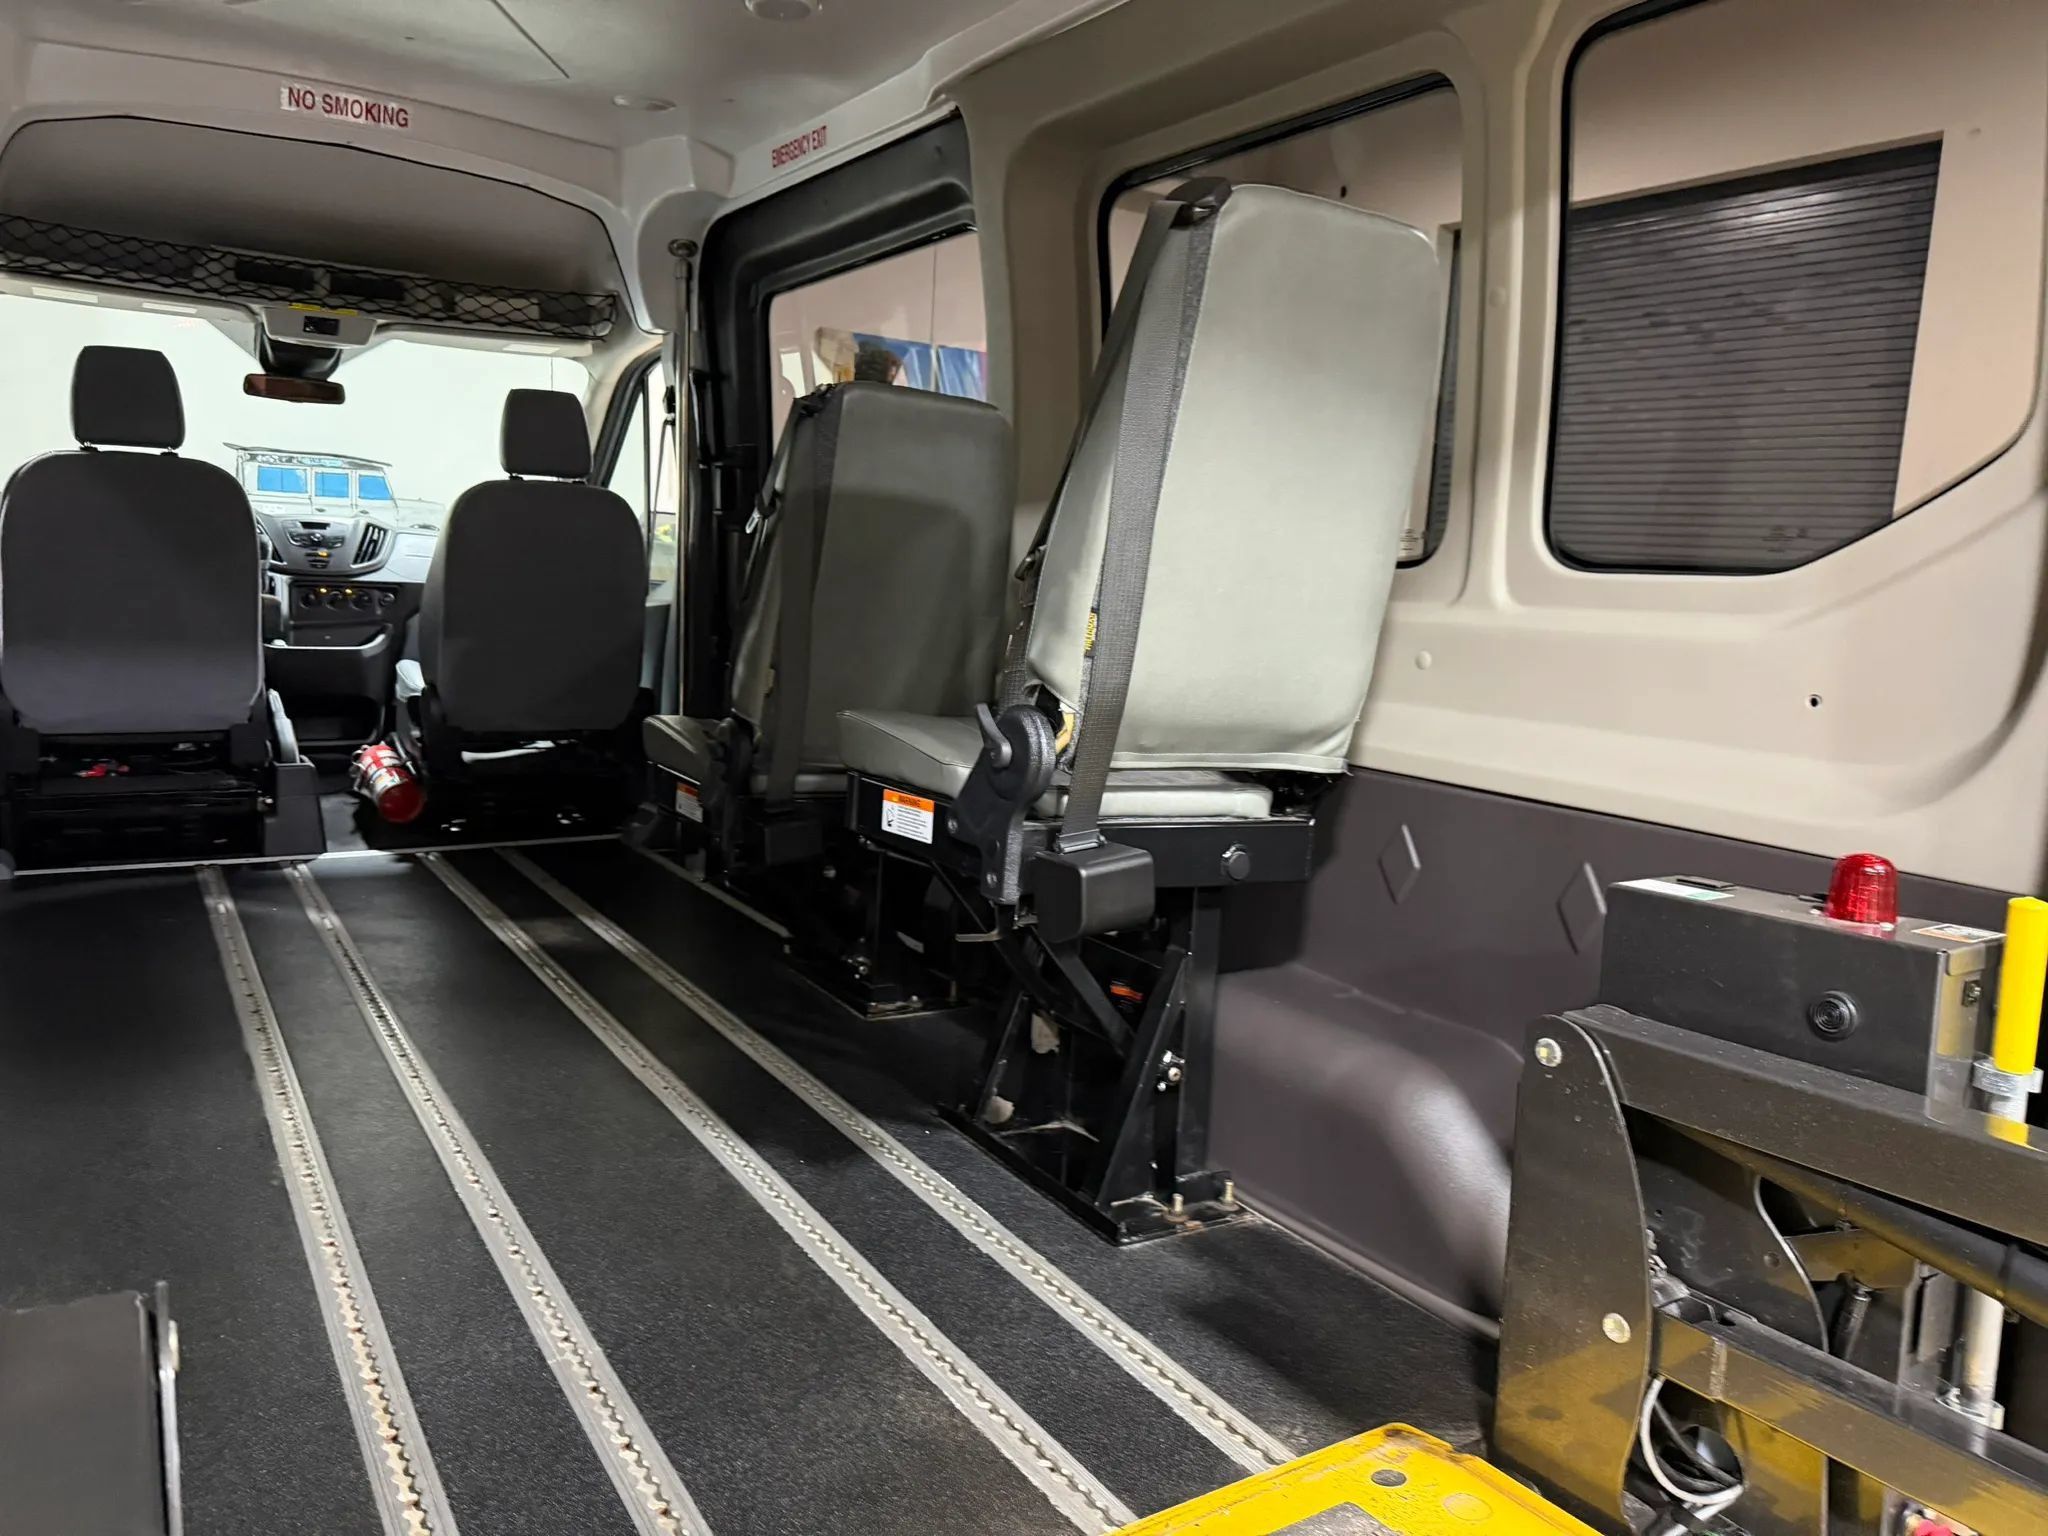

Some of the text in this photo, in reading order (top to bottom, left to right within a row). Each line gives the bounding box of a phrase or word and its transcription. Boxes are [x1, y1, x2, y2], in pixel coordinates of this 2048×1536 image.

[288, 86, 409, 128] NO SMOKING
[772, 125, 827, 168] EMERGENCY EXIT
